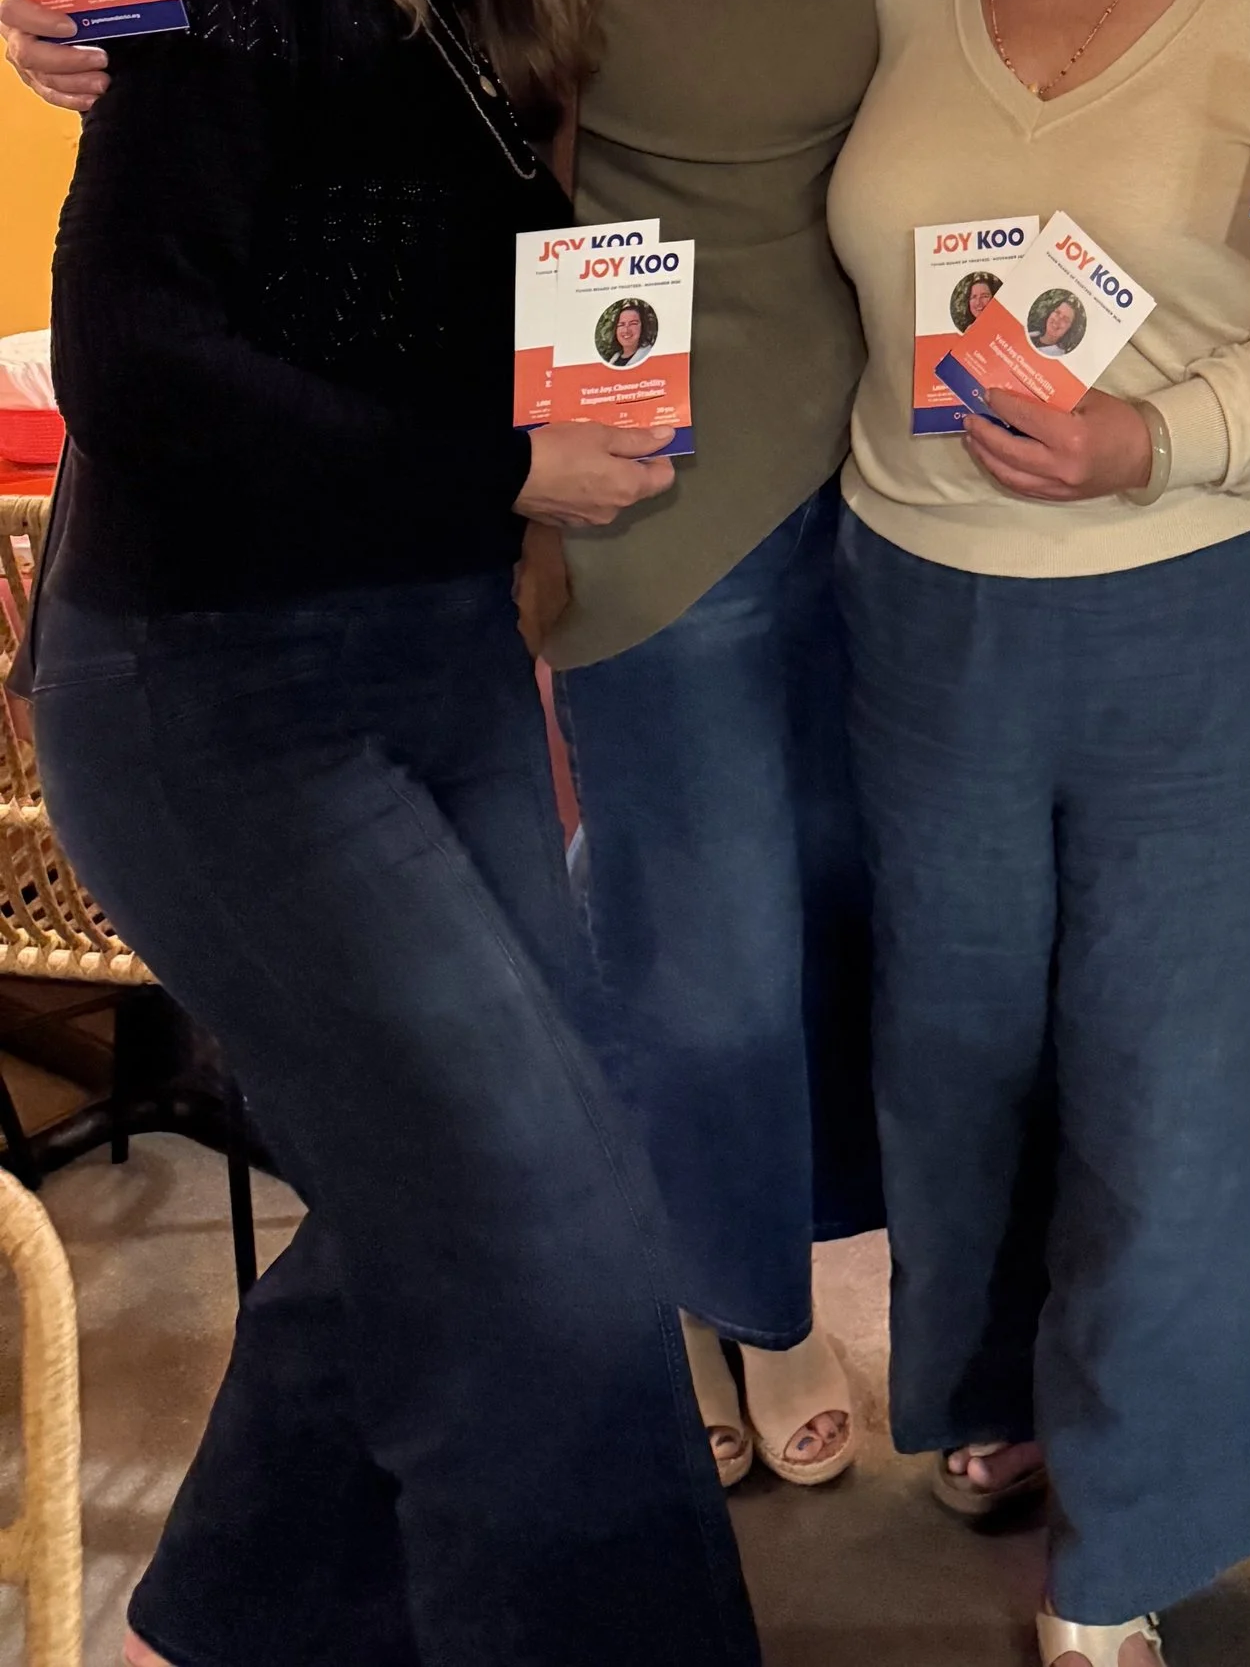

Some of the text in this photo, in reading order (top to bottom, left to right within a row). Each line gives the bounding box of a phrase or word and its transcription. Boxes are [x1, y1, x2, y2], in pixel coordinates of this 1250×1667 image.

[539, 232, 643, 261] JOY KOO
[933, 228, 1024, 254] JOY KOO
[580, 253, 679, 279] JOY KOO
[1056, 235, 1133, 308] JOY KOO
[996, 334, 1008, 348] Vote
[581, 396, 615, 405] Empower
[616, 393, 636, 401] Every
